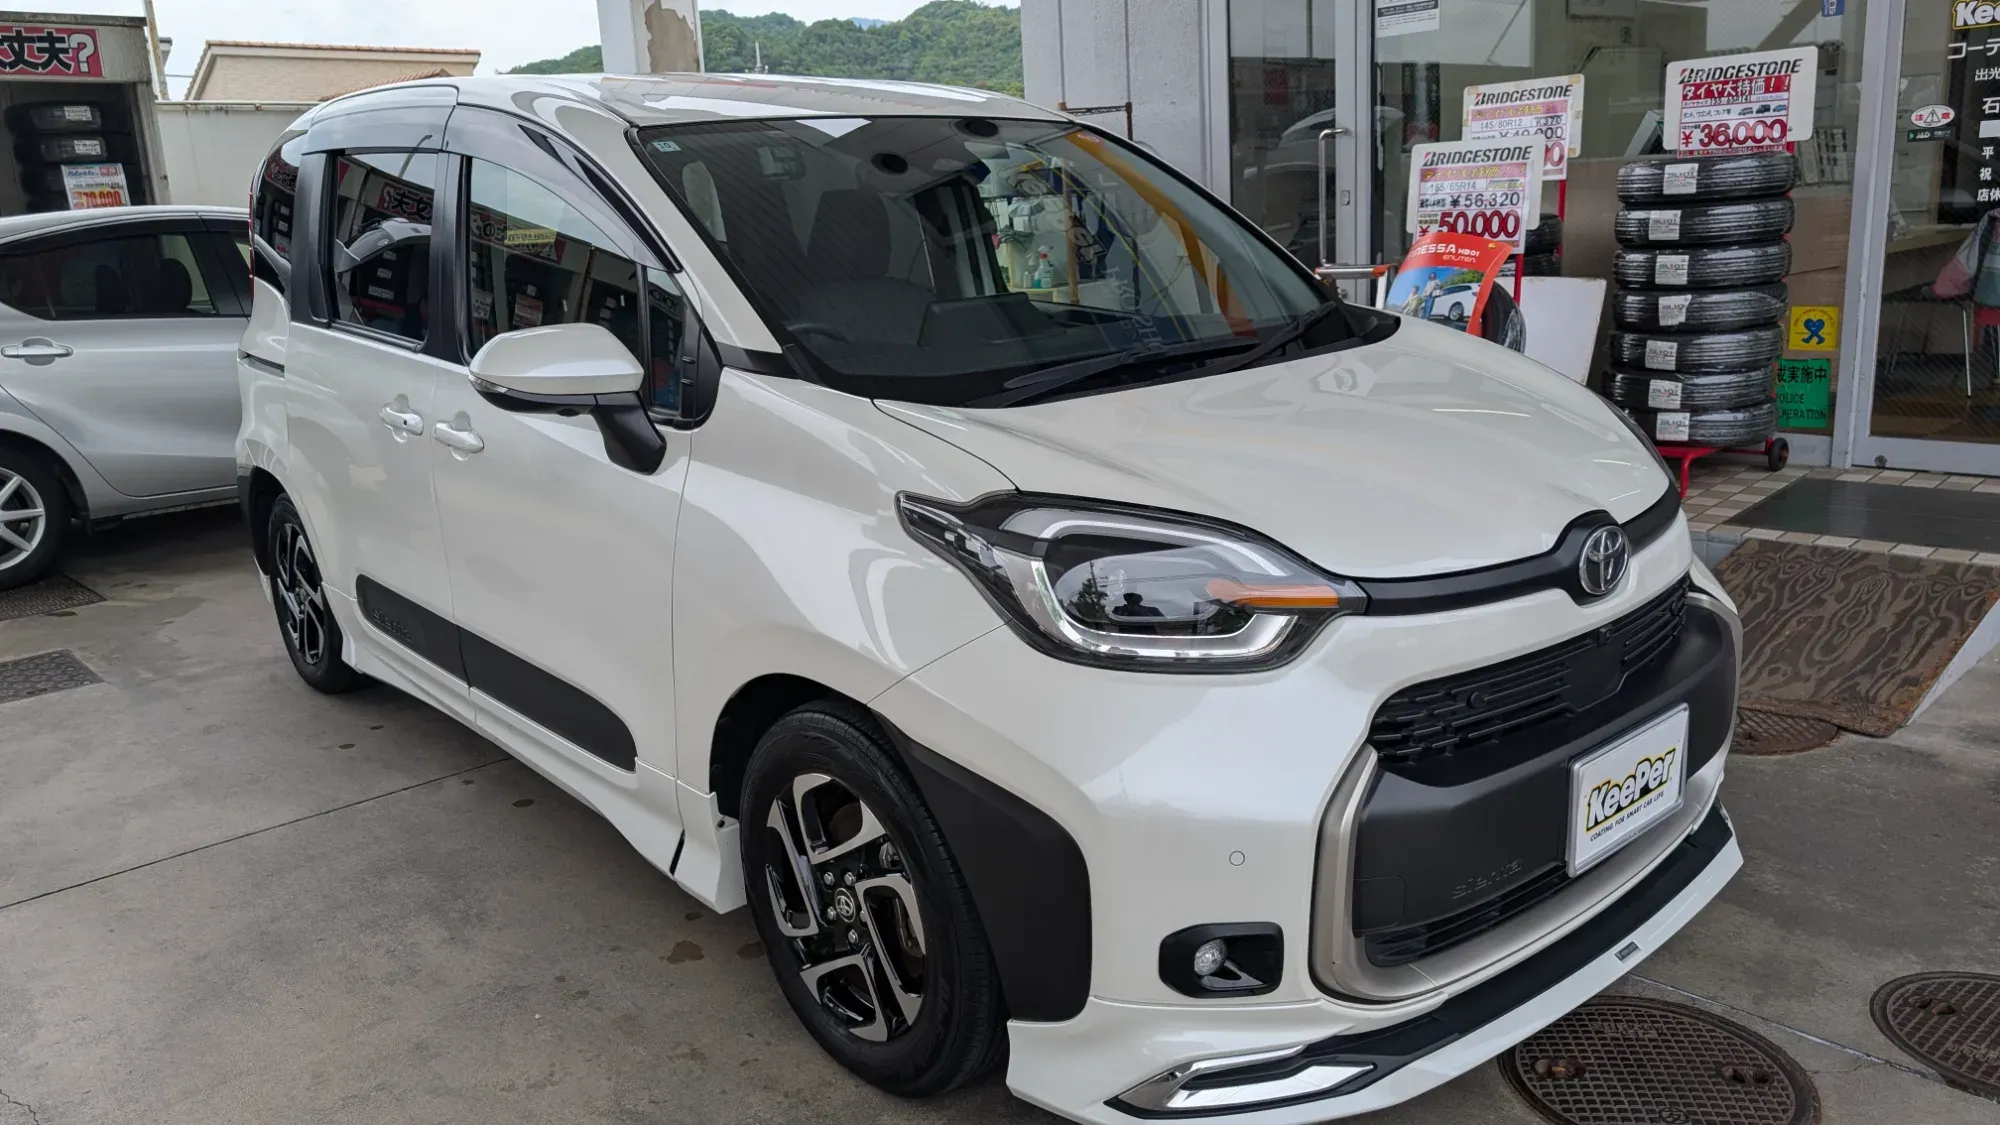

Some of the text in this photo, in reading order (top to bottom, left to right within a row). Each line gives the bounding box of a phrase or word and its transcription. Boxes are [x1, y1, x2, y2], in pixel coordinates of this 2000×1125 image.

[0, 29, 96, 73] 丈夫？
[1678, 59, 1803, 85] BRIDGESTONE
[1974, 67, 2000, 81] 出光
[1683, 76, 1790, 100] タイヤ大特価！！
[1474, 84, 1573, 106] BRIDGESTONE
[1480, 118, 1523, 130] 145/80R12
[1682, 119, 1787, 148] ¥ 36,000
[657, 141, 671, 150] 10
[1423, 146, 1533, 167] BRIDGESTONE
[1981, 146, 1994, 159] 平
[1979, 167, 1992, 180] 祝
[1429, 182, 1476, 193] 165/65R14
[1977, 188, 2000, 201] 店休
[1457, 249, 1480, 257] HB01
[1777, 392, 1804, 404] OLICE
[1779, 409, 1825, 420] PERATION
[1586, 747, 1676, 833] KeePer
[1589, 822, 1614, 842] COATING
[1614, 815, 1625, 827] FOR
[1626, 805, 1642, 820] SMART
[1643, 798, 1653, 809] CAR
[1654, 790, 1664, 803] LIFE
